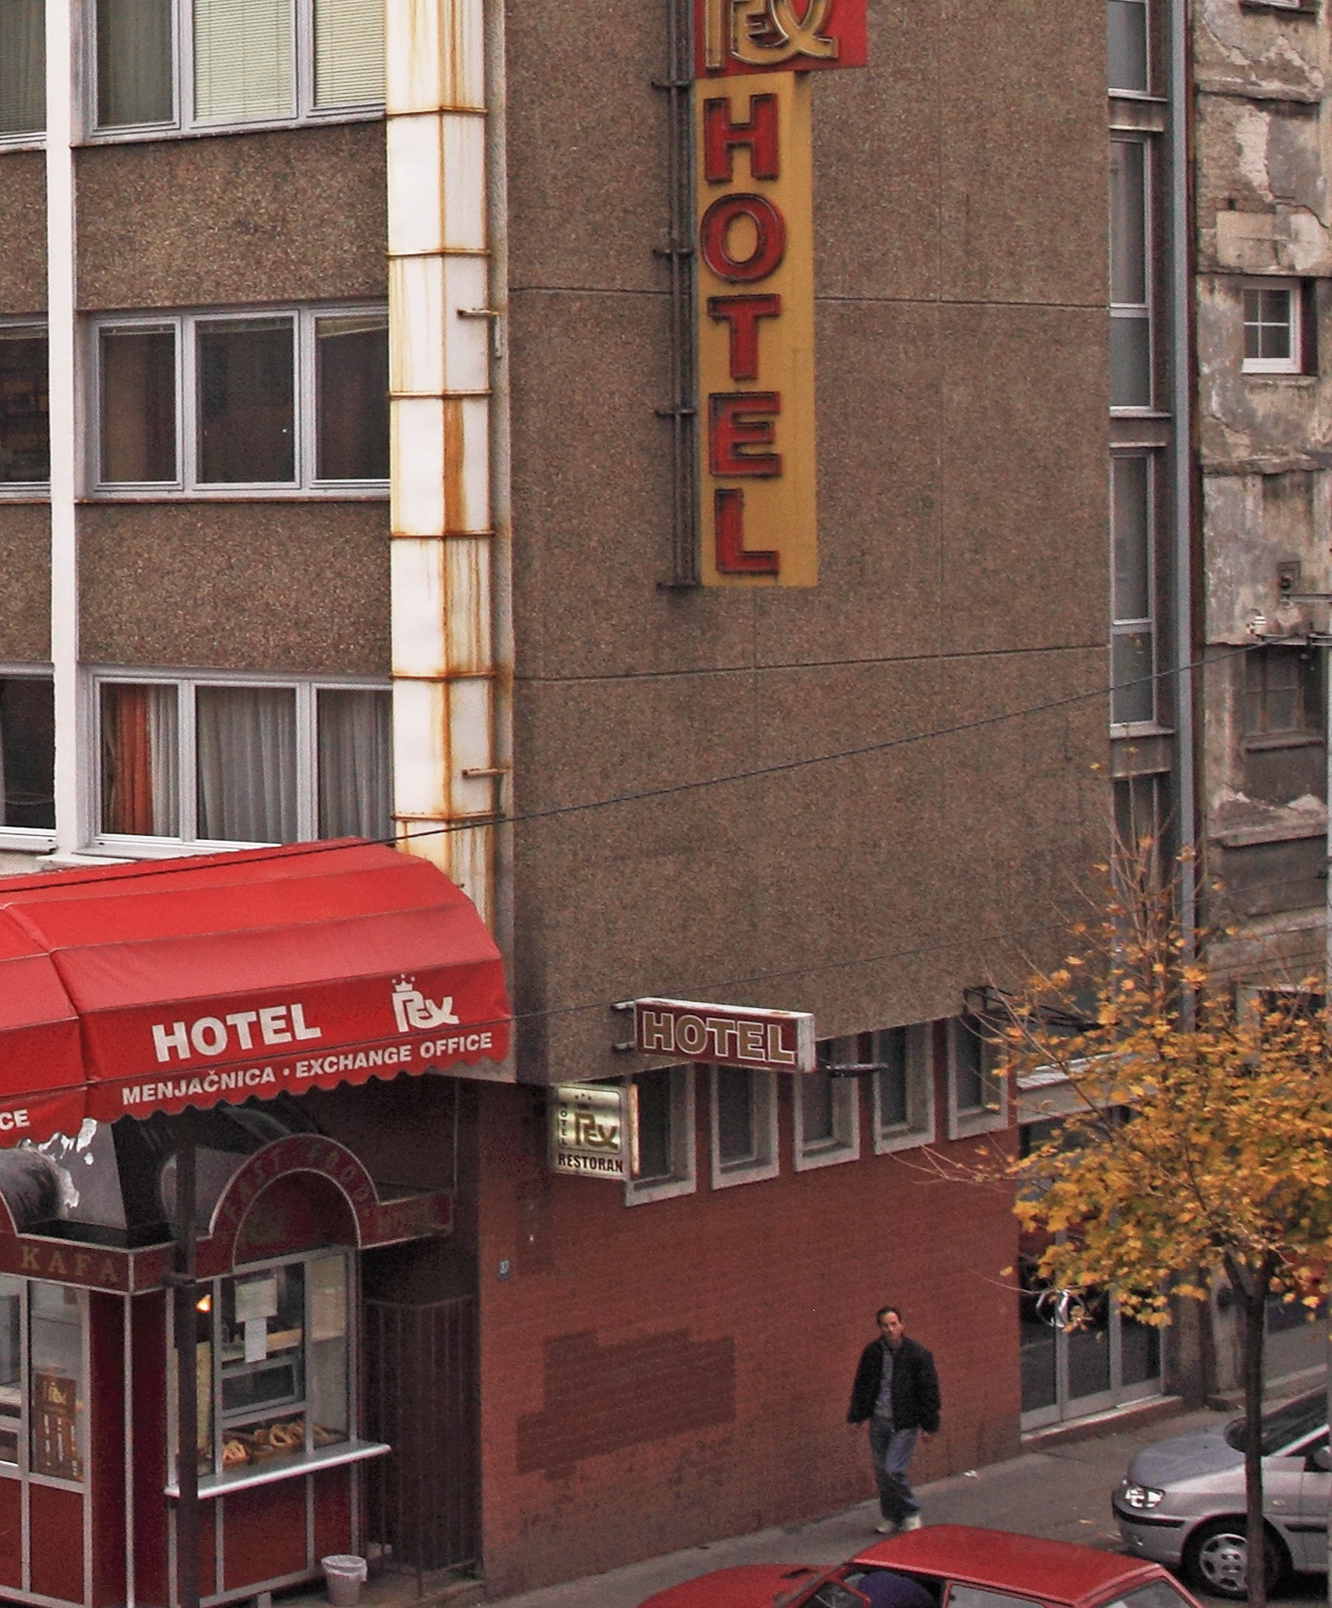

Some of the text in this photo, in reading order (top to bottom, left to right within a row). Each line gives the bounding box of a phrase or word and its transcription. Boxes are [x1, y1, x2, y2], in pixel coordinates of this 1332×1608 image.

[700, 93, 786, 574] HOTEL
[152, 1004, 322, 1062] HOTEL
[642, 1010, 796, 1065] HOTEL
[122, 1032, 493, 1105] MENJAČNICA EXCHANGE OFFICE
[557, 1153, 624, 1173] RESTORAN
[20, 1246, 119, 1283] KAFA
